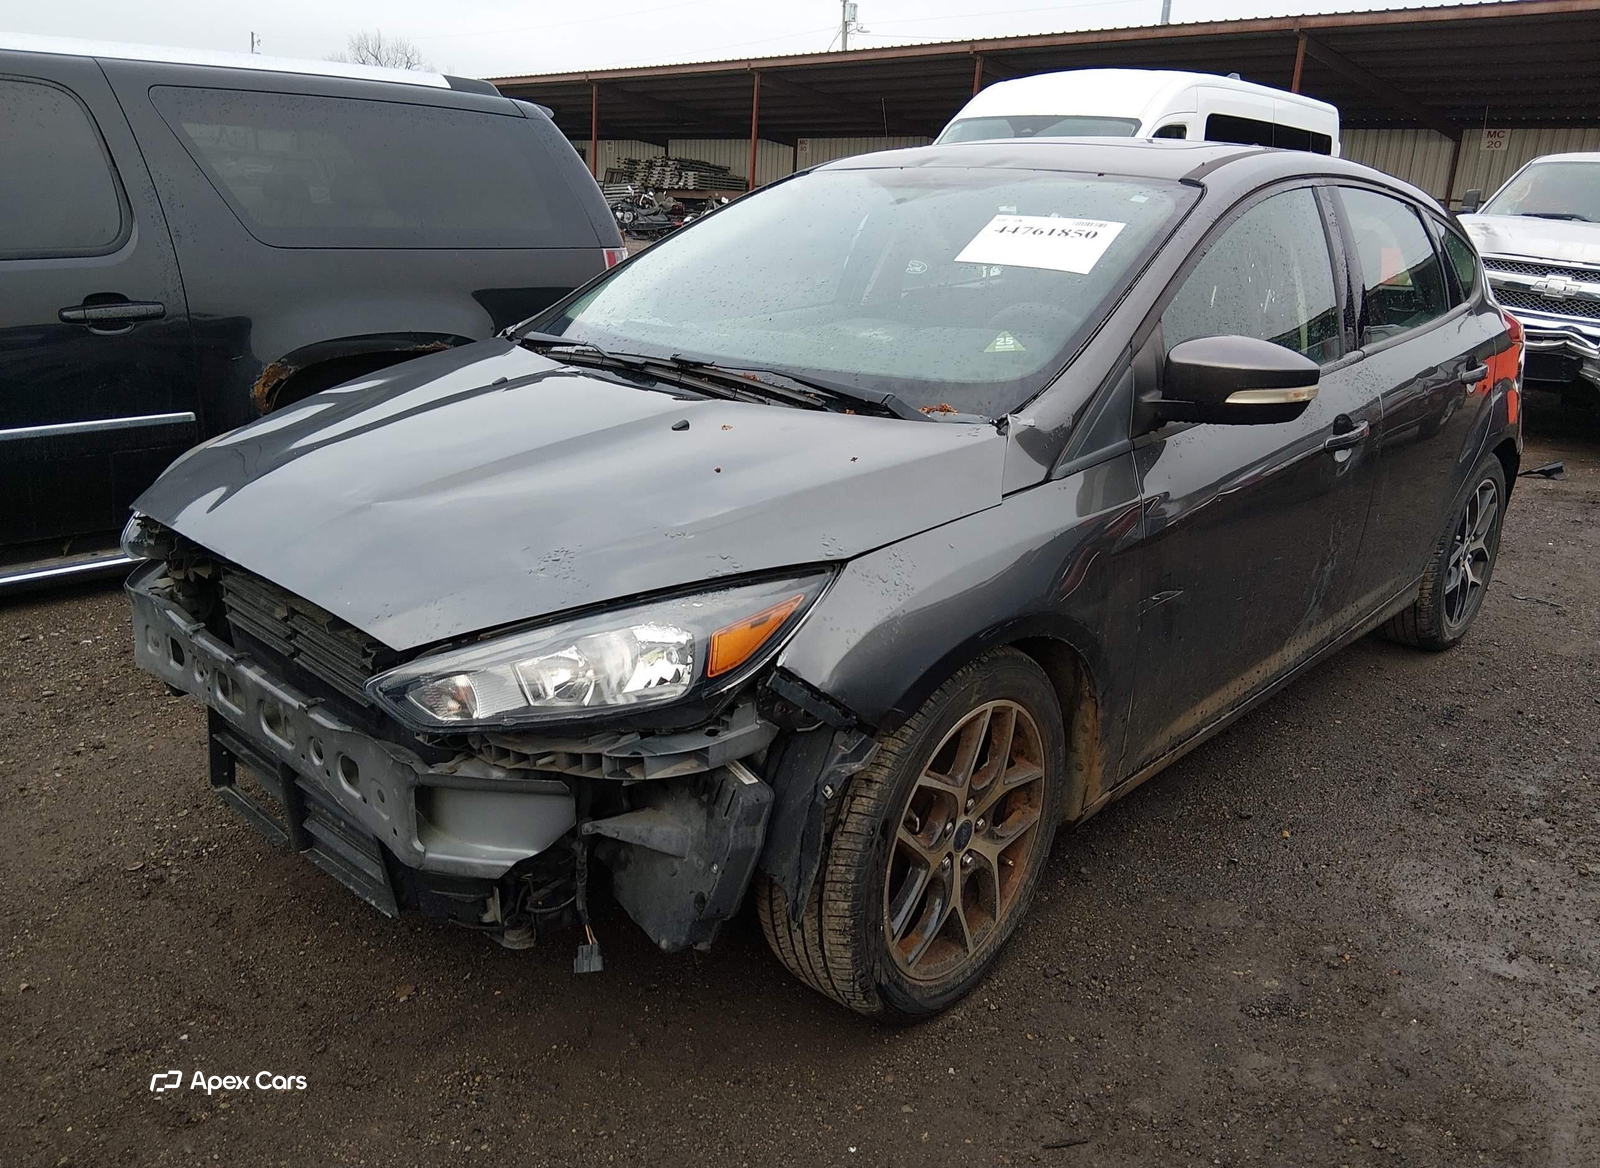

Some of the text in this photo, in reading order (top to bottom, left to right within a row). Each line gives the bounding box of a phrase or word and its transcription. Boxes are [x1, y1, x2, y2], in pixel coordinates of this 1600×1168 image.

[1486, 130, 1506, 139] MC
[994, 225, 1098, 240] 44761850
[996, 337, 1014, 346] 25
